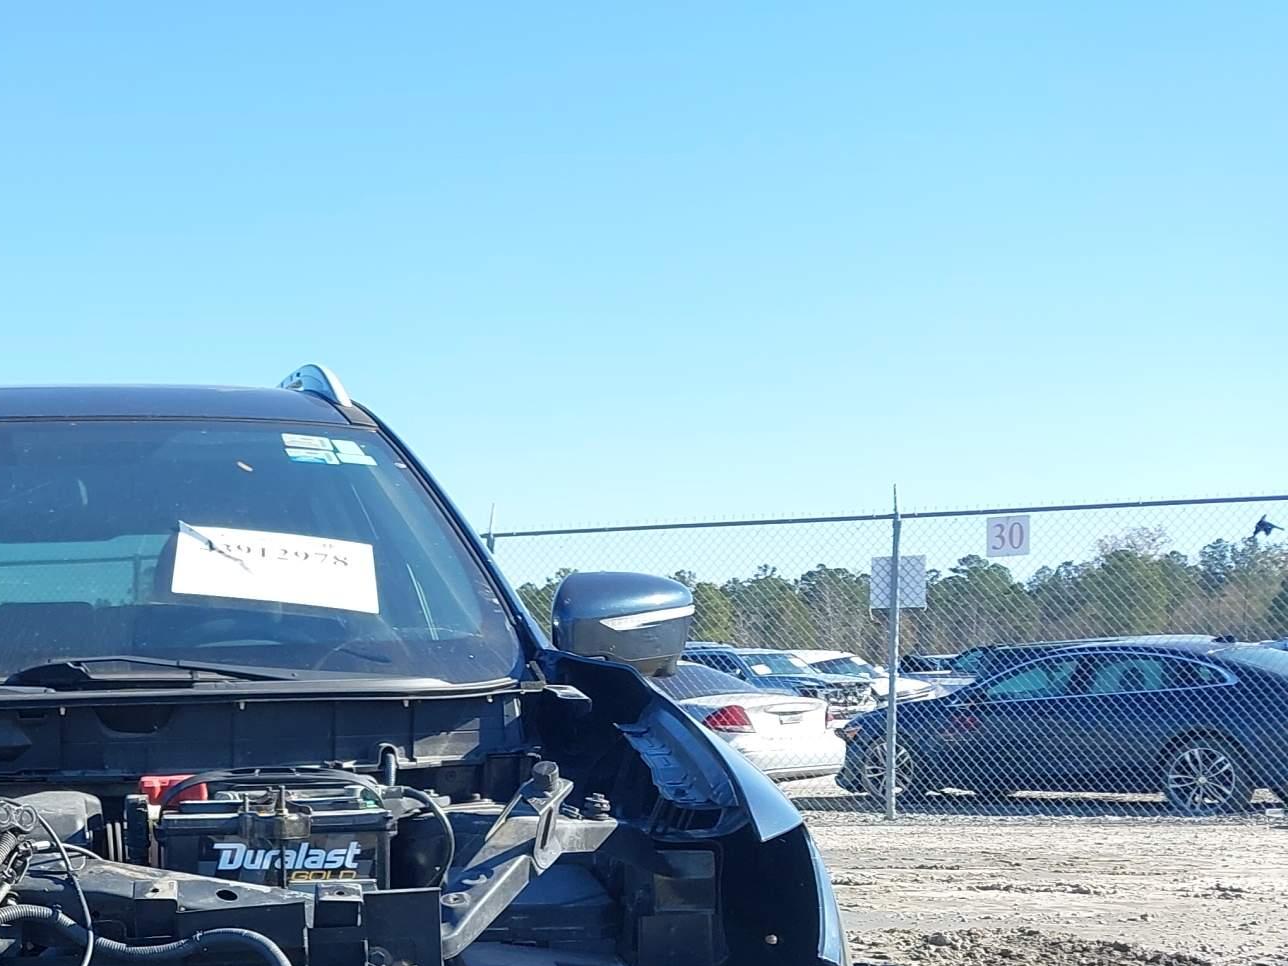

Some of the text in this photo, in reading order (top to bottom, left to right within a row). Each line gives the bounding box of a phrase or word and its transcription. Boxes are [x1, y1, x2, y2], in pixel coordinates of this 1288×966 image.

[991, 521, 1025, 551] 30
[200, 541, 350, 567] 3912978
[212, 840, 361, 871] Duralast
[290, 869, 358, 881] GOLD
